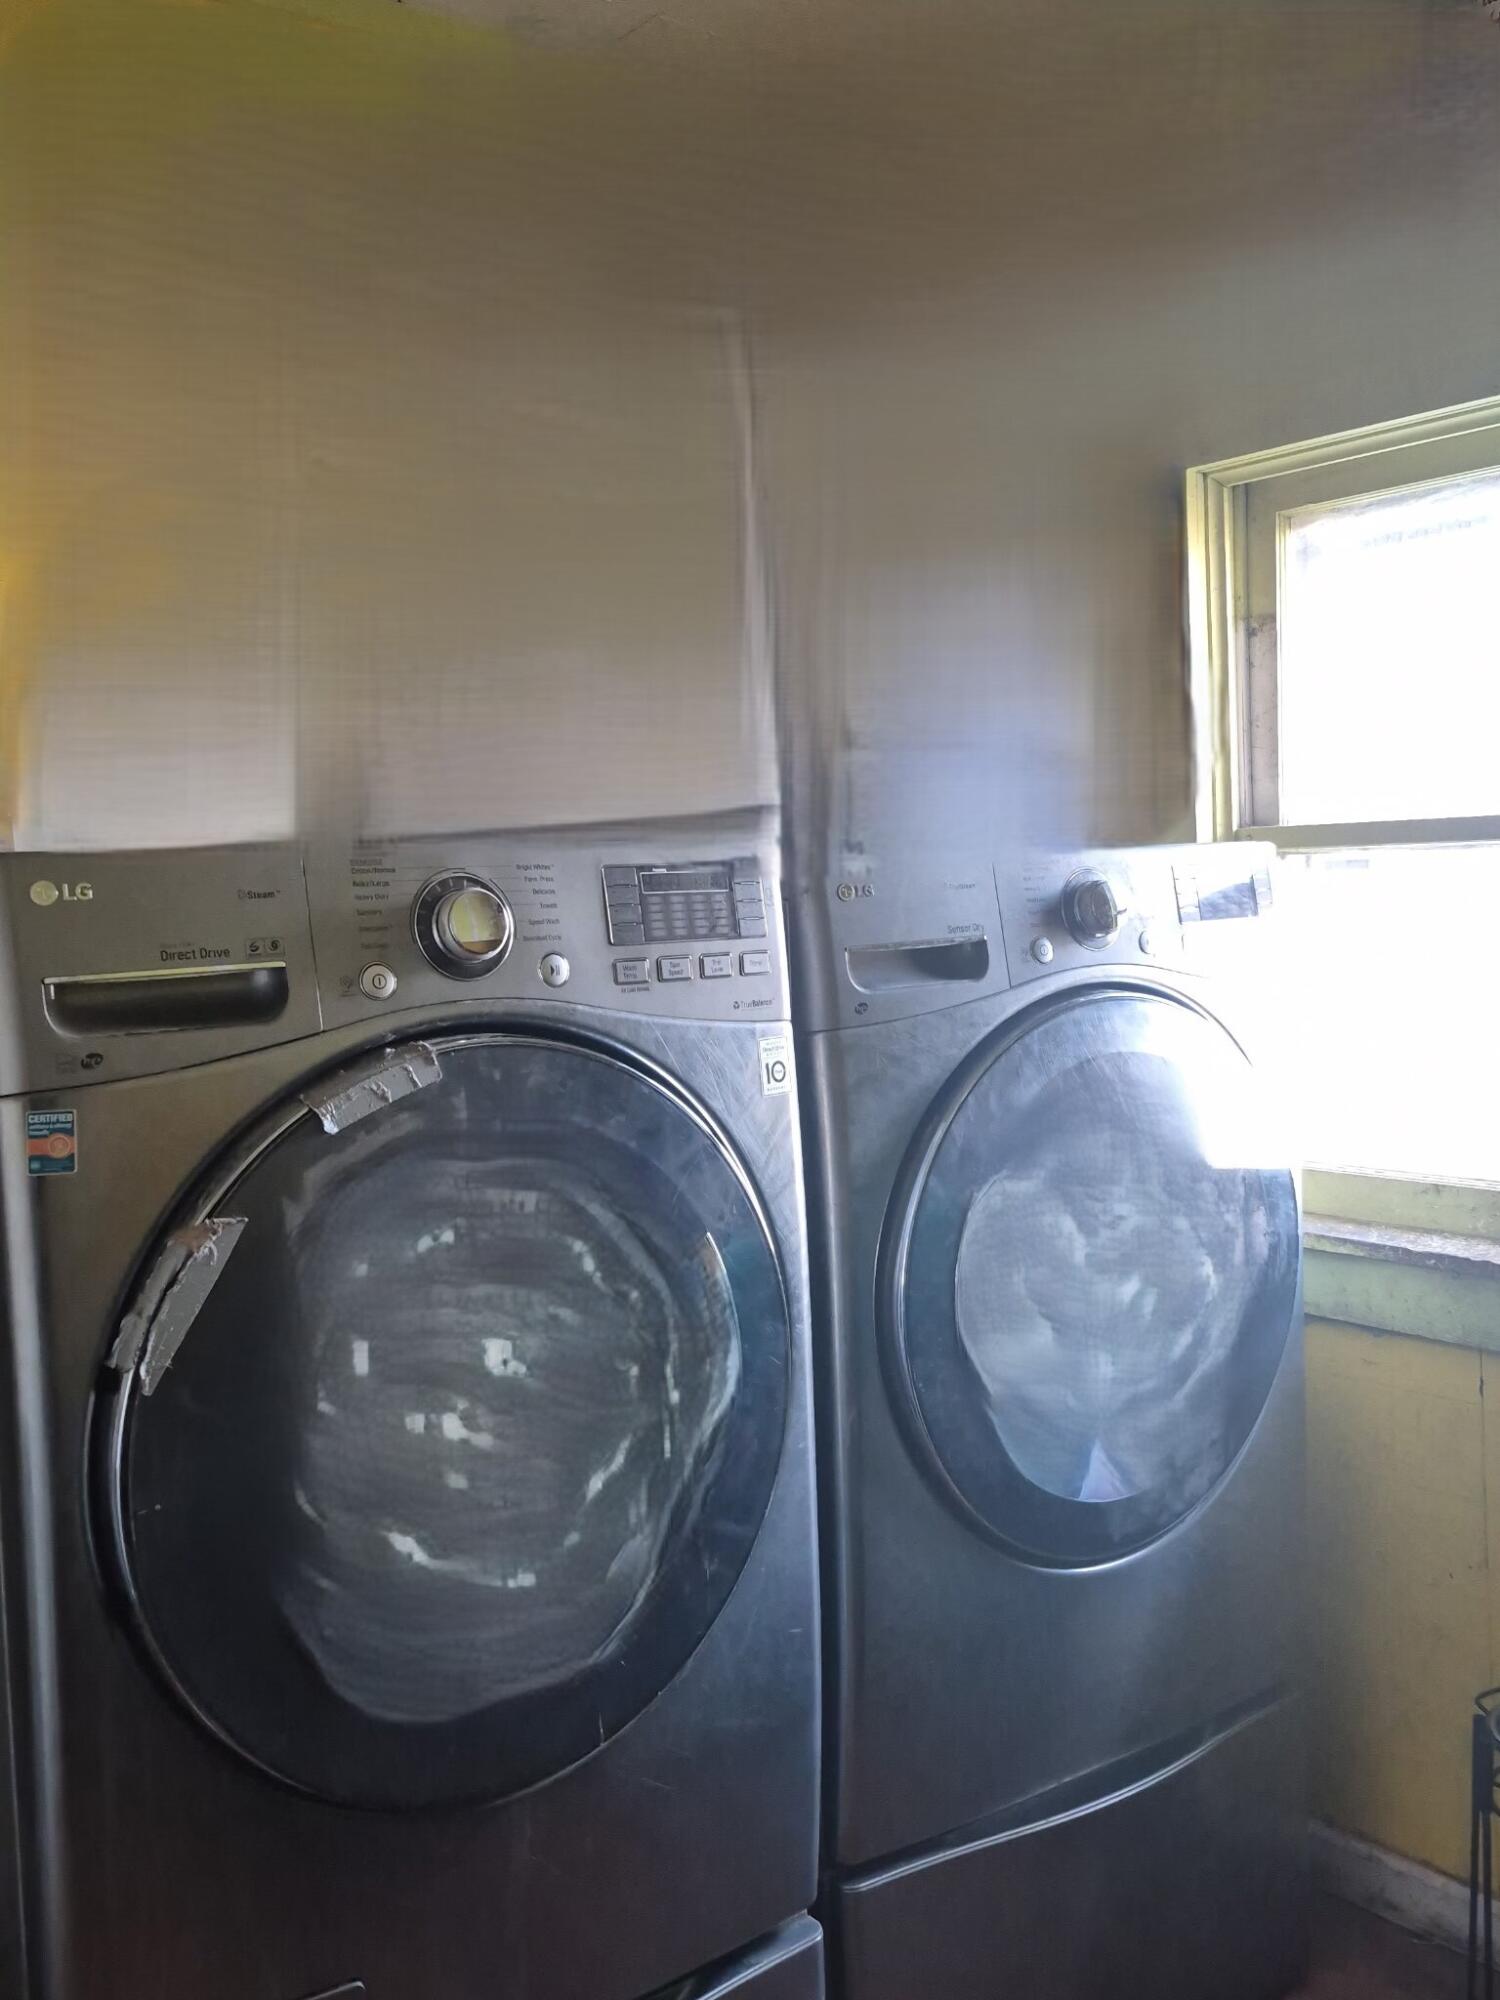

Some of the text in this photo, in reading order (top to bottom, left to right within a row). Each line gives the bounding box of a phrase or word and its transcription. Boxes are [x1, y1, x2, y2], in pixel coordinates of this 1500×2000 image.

[62, 883, 93, 901] LG
[854, 883, 874, 898] LG
[946, 924, 971, 935] Sensor
[160, 946, 231, 962] Direct Drive
[765, 1060, 787, 1085] 10
[28, 1113, 73, 1124] CERTIFIED
